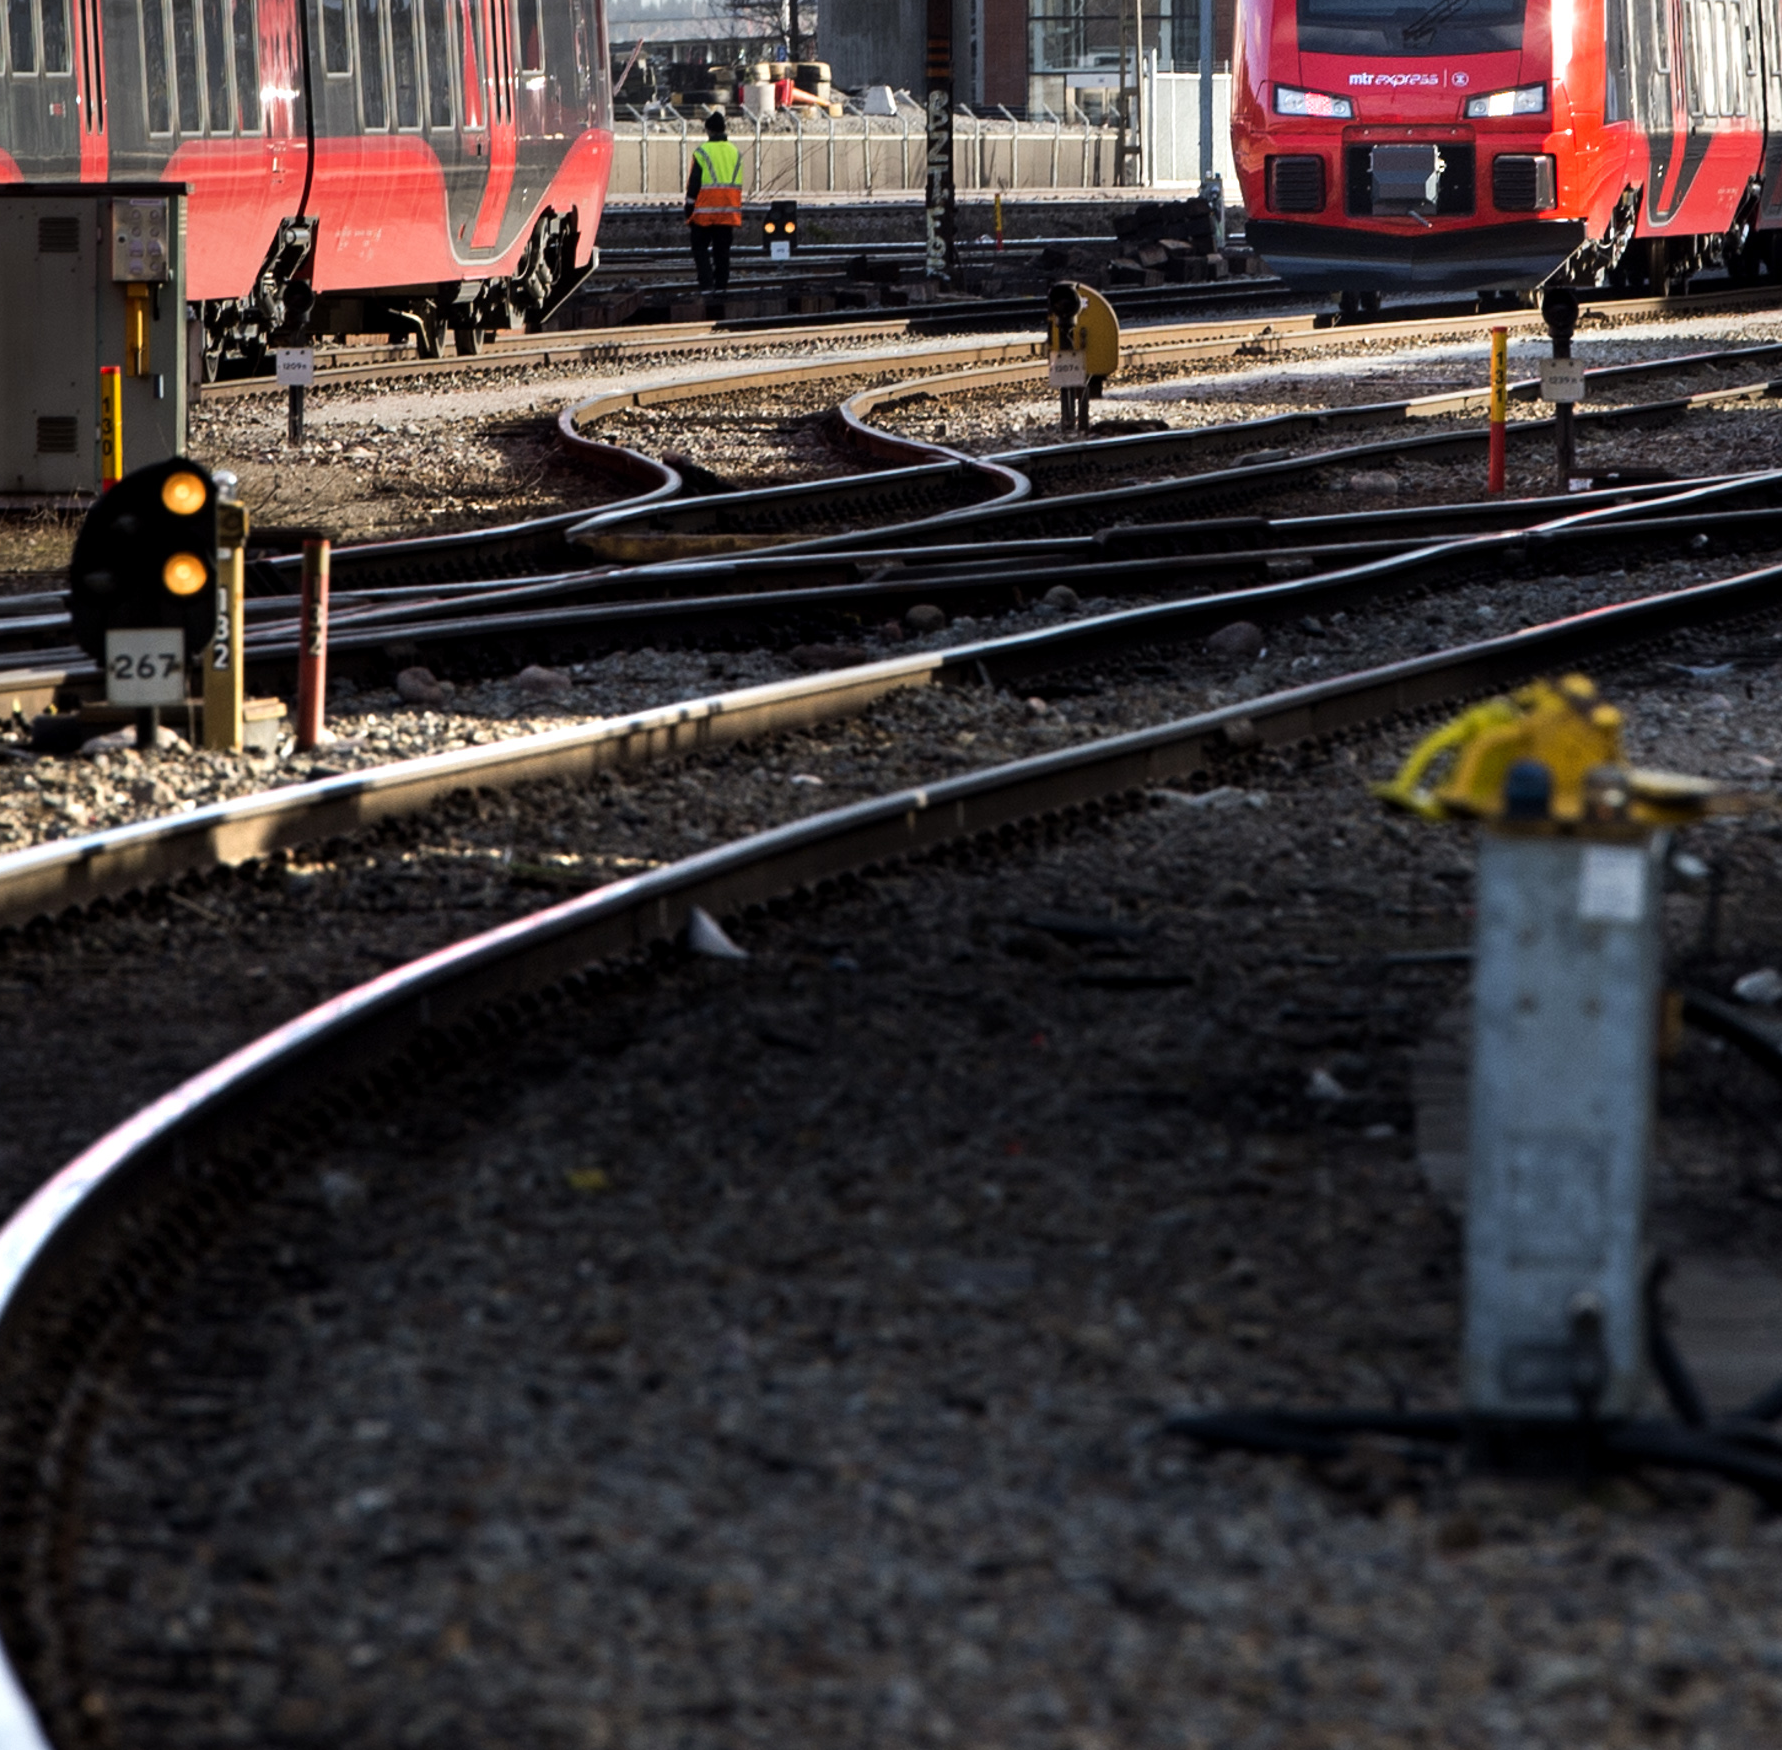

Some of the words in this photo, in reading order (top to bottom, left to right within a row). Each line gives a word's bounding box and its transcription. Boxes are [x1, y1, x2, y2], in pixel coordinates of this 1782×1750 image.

[1349, 72, 1374, 86] mtr
[1375, 73, 1439, 88] express
[1495, 351, 1504, 403] 131
[102, 397, 113, 456] 130
[213, 587, 230, 669] 132
[115, 653, 177, 680] 267
